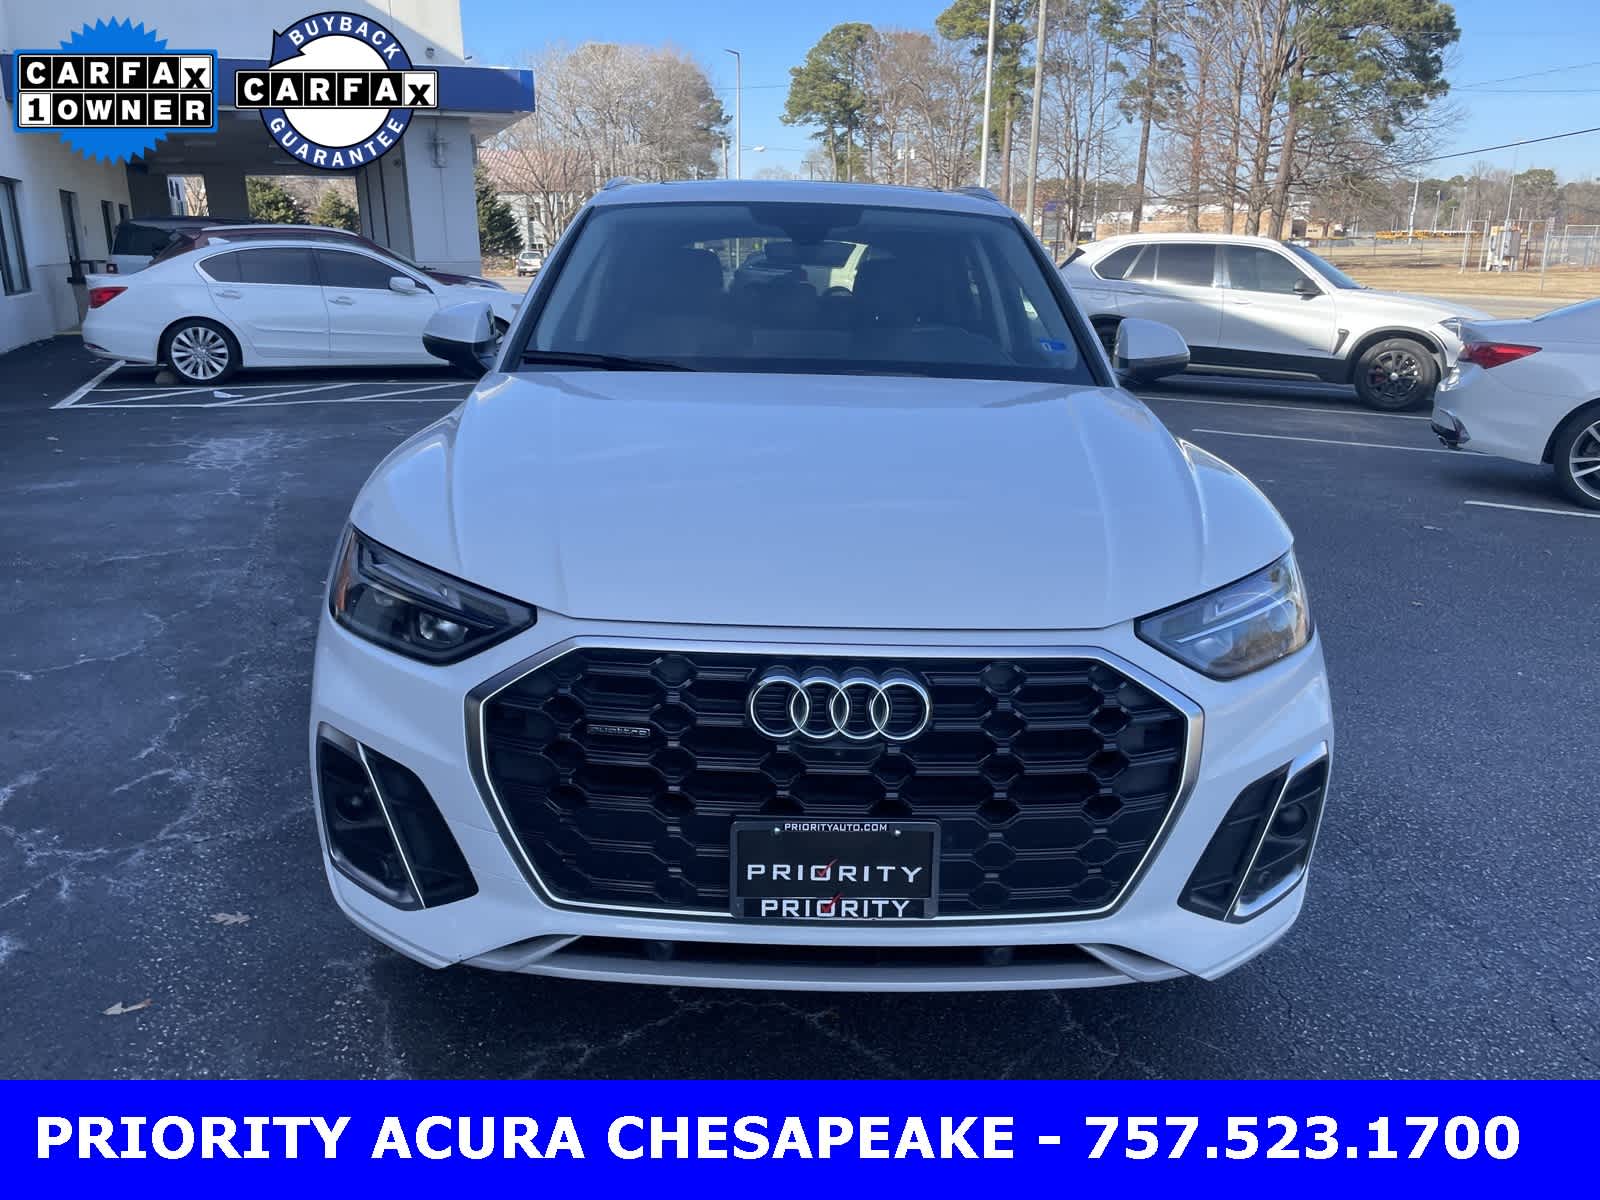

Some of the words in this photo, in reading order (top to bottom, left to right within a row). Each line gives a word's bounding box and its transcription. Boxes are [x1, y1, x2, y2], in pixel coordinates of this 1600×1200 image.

[784, 823, 888, 832] PRIORITYAUTO.COM
[747, 864, 922, 883] PRIORITY
[761, 899, 911, 917] PRIORITY
